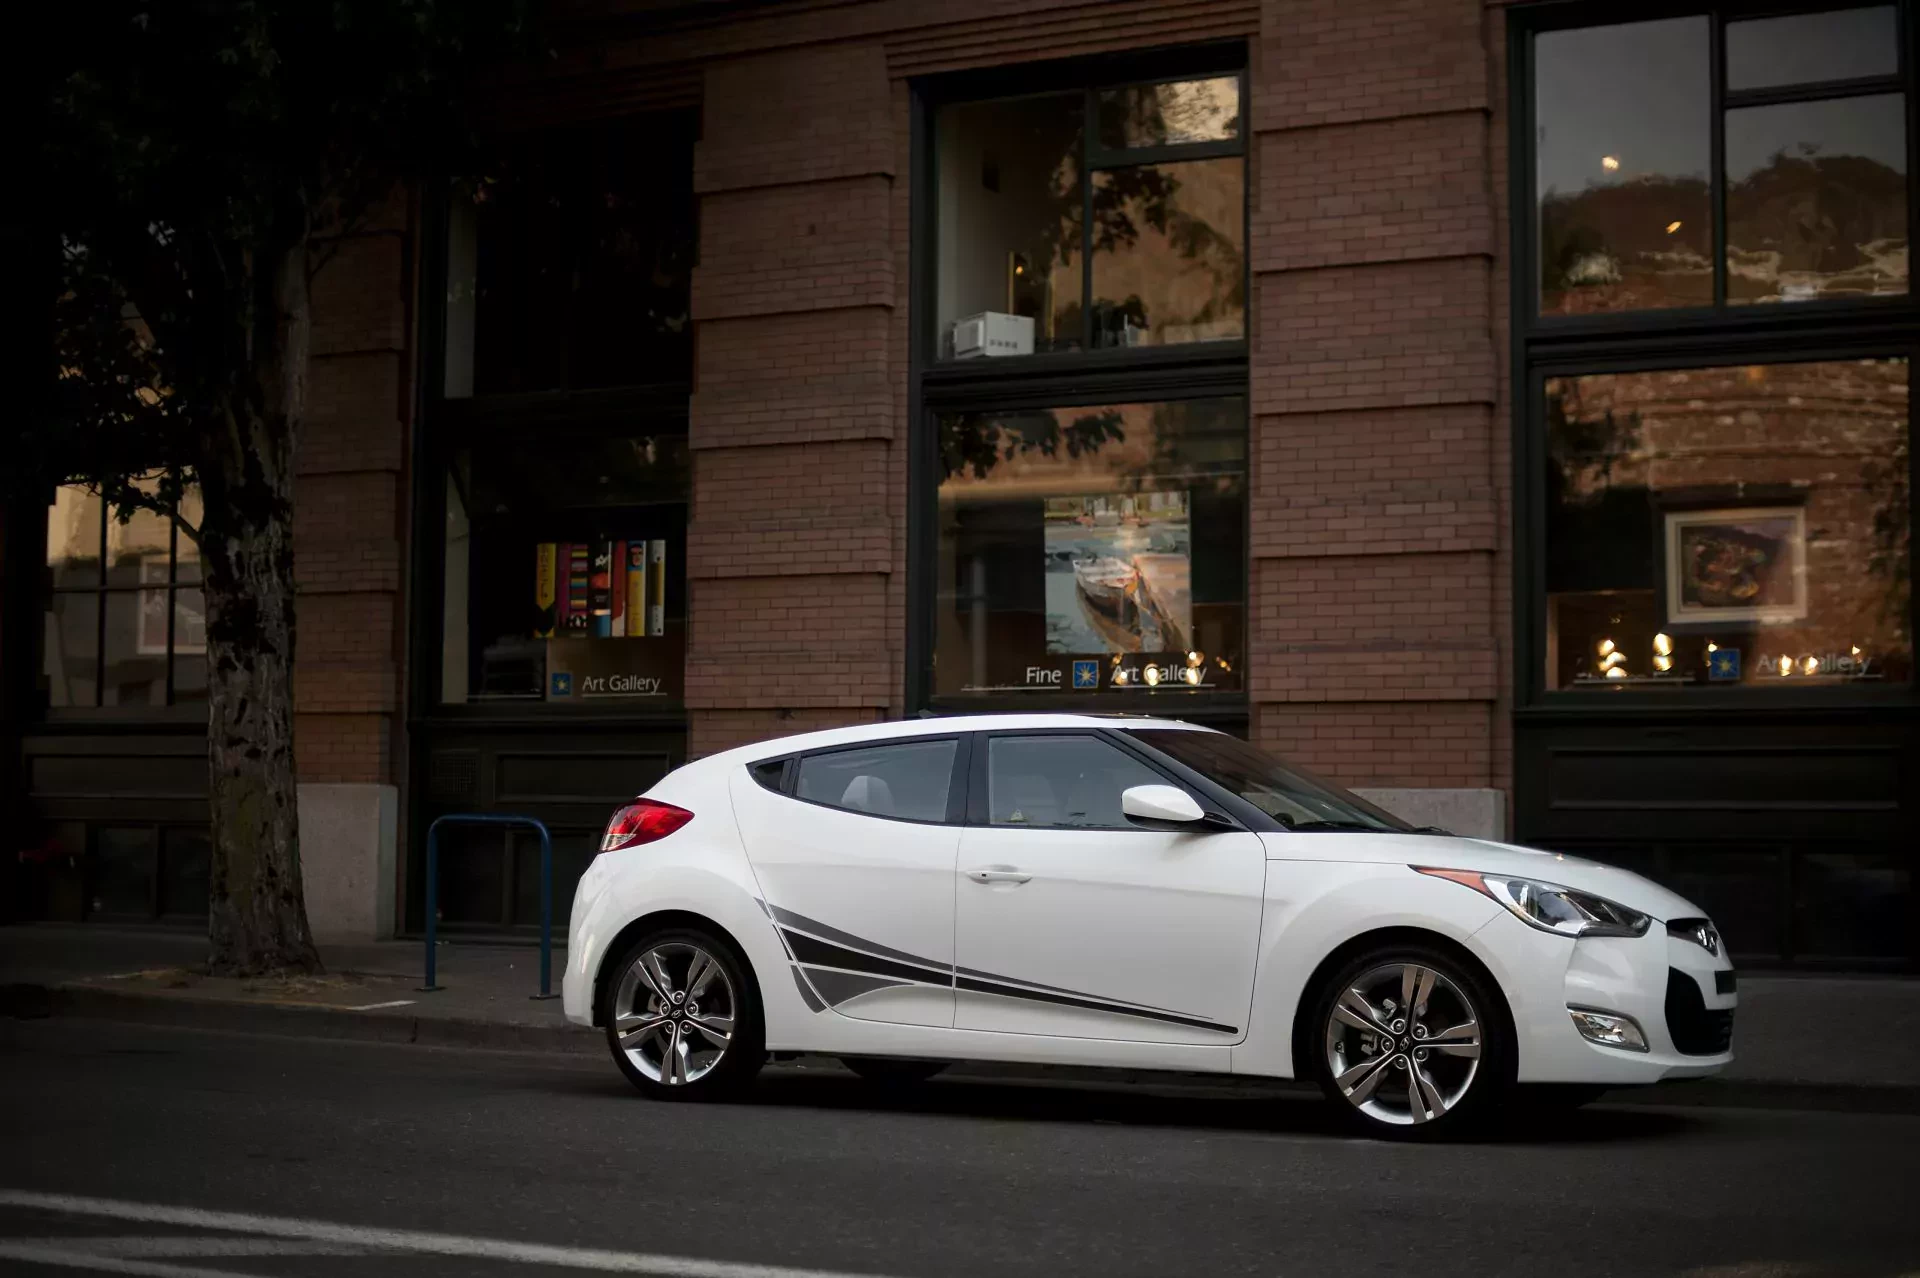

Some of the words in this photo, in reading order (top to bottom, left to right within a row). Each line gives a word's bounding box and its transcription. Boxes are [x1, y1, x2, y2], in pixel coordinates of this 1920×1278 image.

[1755, 653, 1789, 672] Ar
[582, 675, 605, 691] Art
[609, 674, 661, 695] Gallery
[1026, 665, 1062, 684] Fine
[1110, 664, 1139, 682] Art
[1144, 663, 1207, 685] Galley
